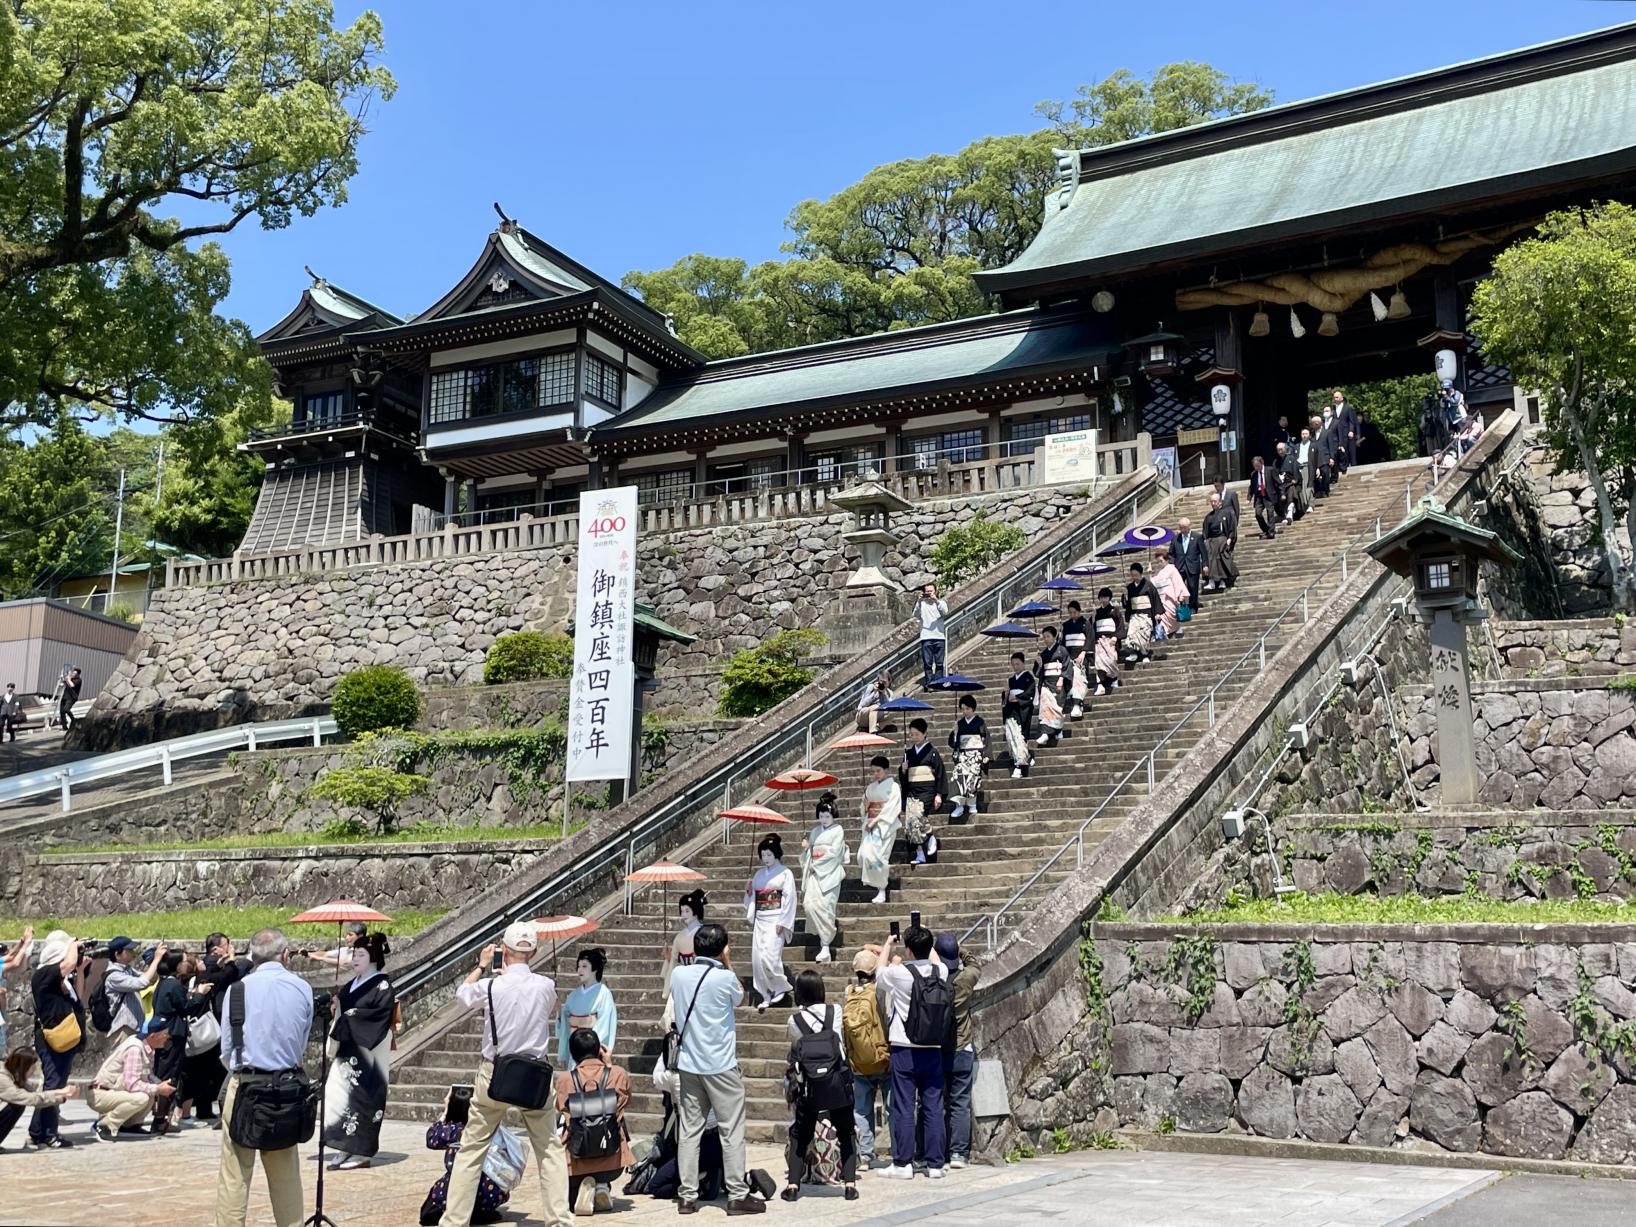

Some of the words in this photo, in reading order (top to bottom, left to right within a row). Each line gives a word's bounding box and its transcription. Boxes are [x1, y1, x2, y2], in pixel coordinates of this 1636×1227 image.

[587, 516, 626, 539] 400
[585, 568, 616, 760] 御鎮座四百年
